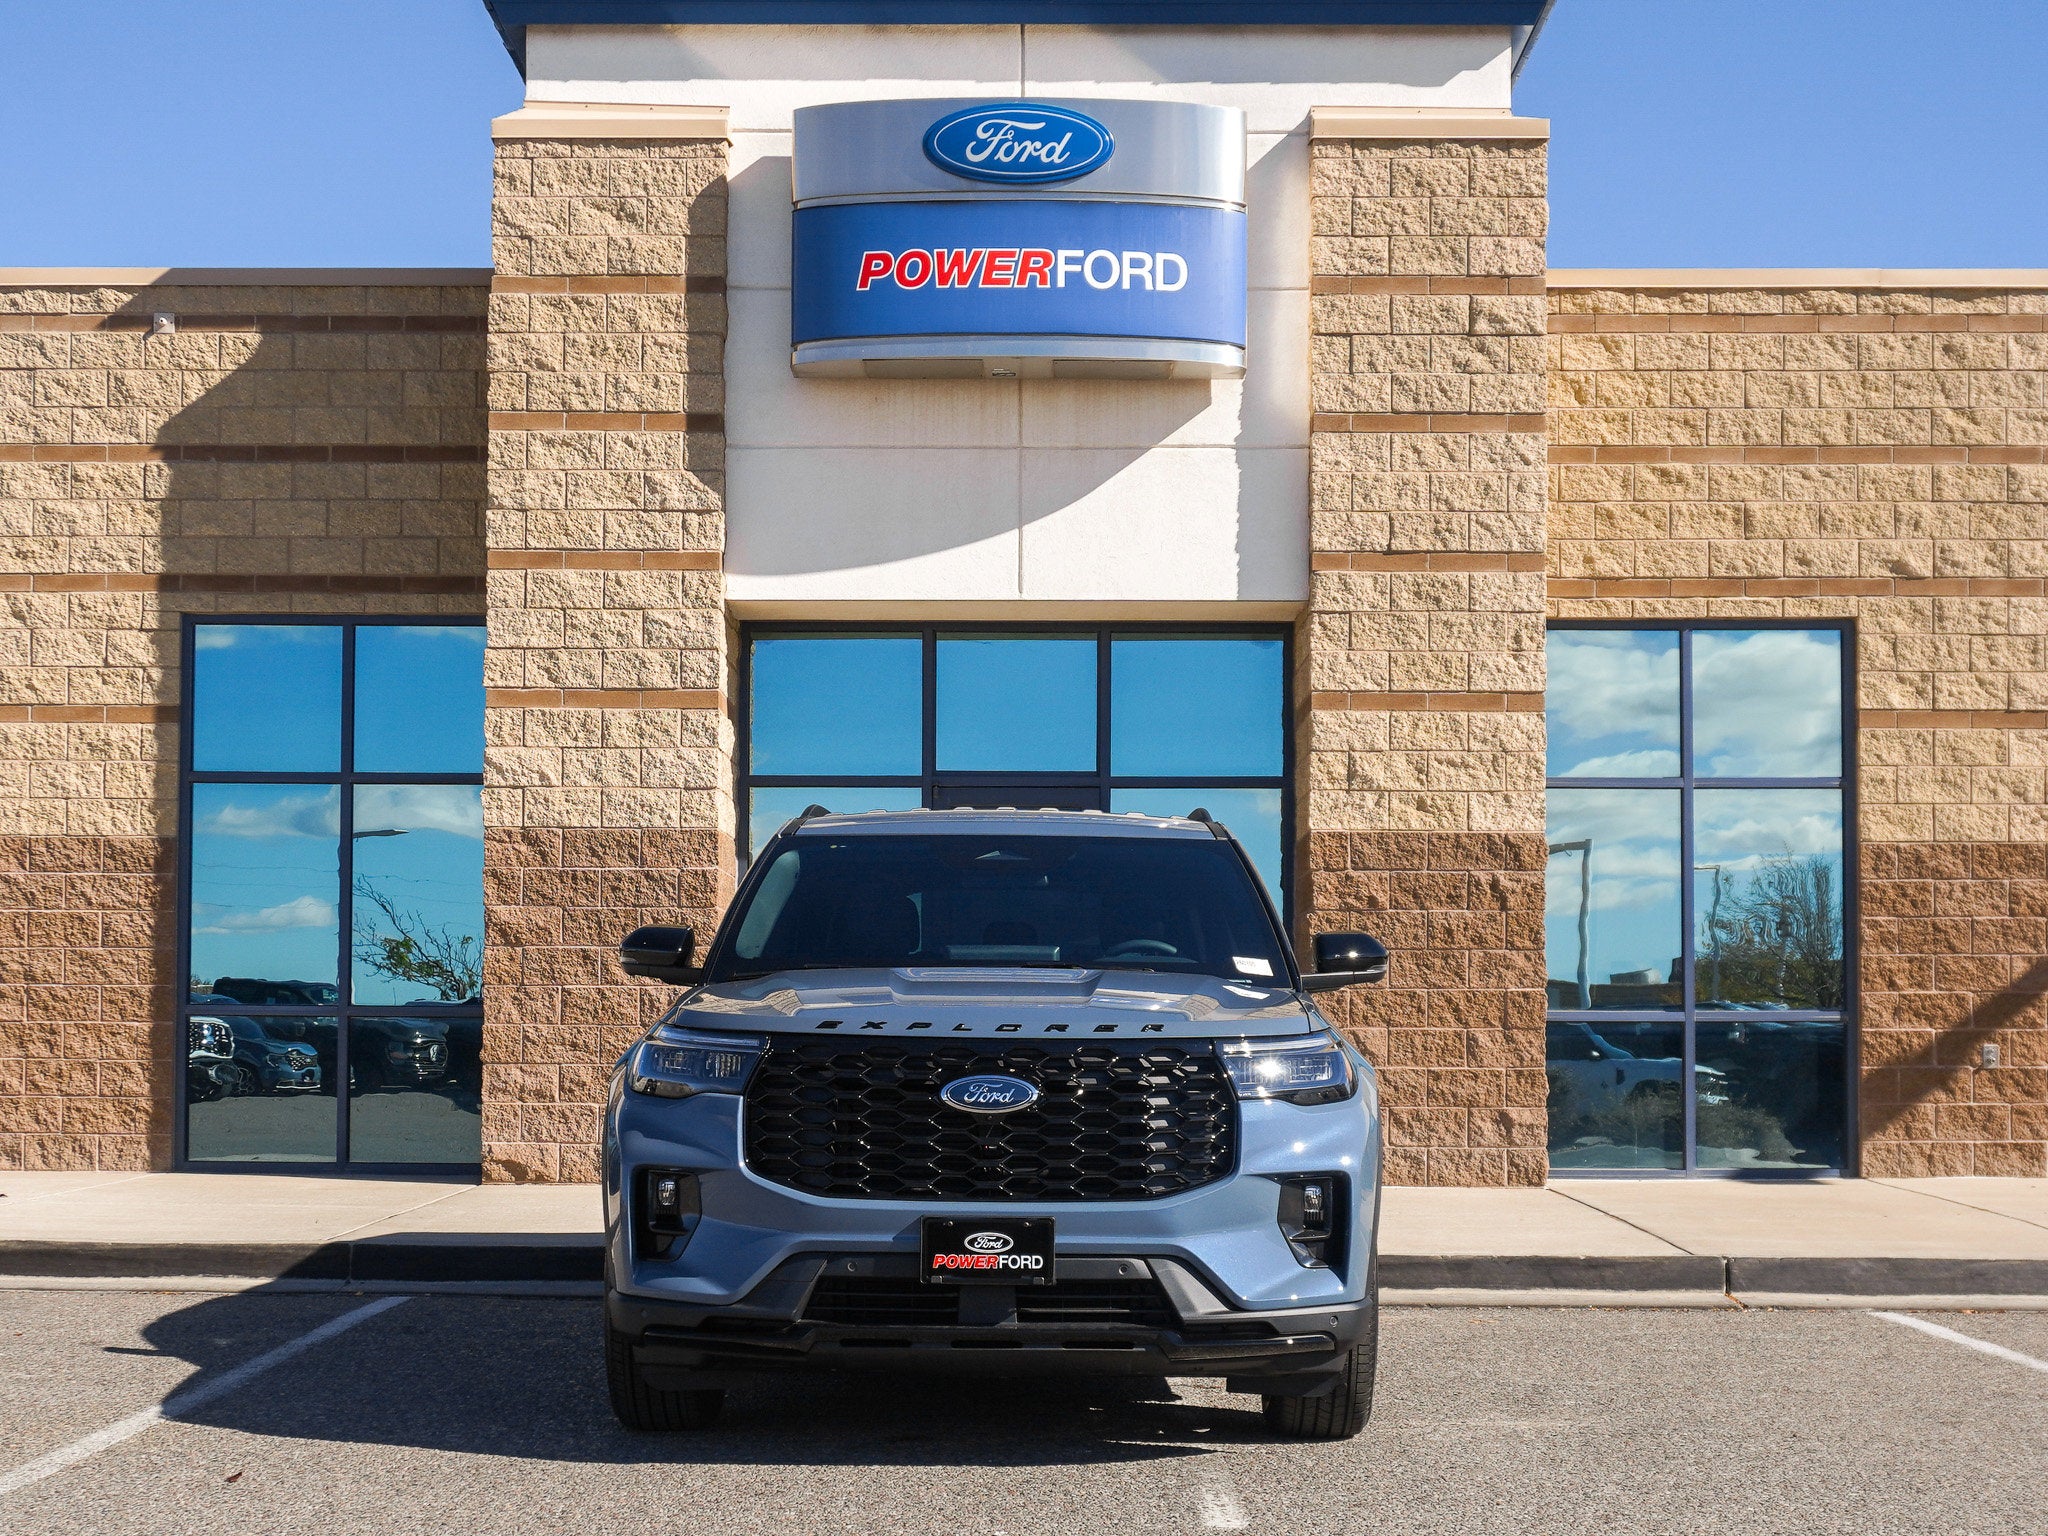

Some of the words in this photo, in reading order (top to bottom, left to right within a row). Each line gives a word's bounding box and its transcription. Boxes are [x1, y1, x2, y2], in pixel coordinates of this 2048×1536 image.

[965, 118, 1073, 165] Ford
[856, 247, 1189, 292] POWERFORD
[815, 1019, 1165, 1034] EXPLORER
[963, 1082, 1015, 1104] Ford
[974, 1236, 1004, 1249] Ford
[932, 1254, 1044, 1269] POWERFORD
